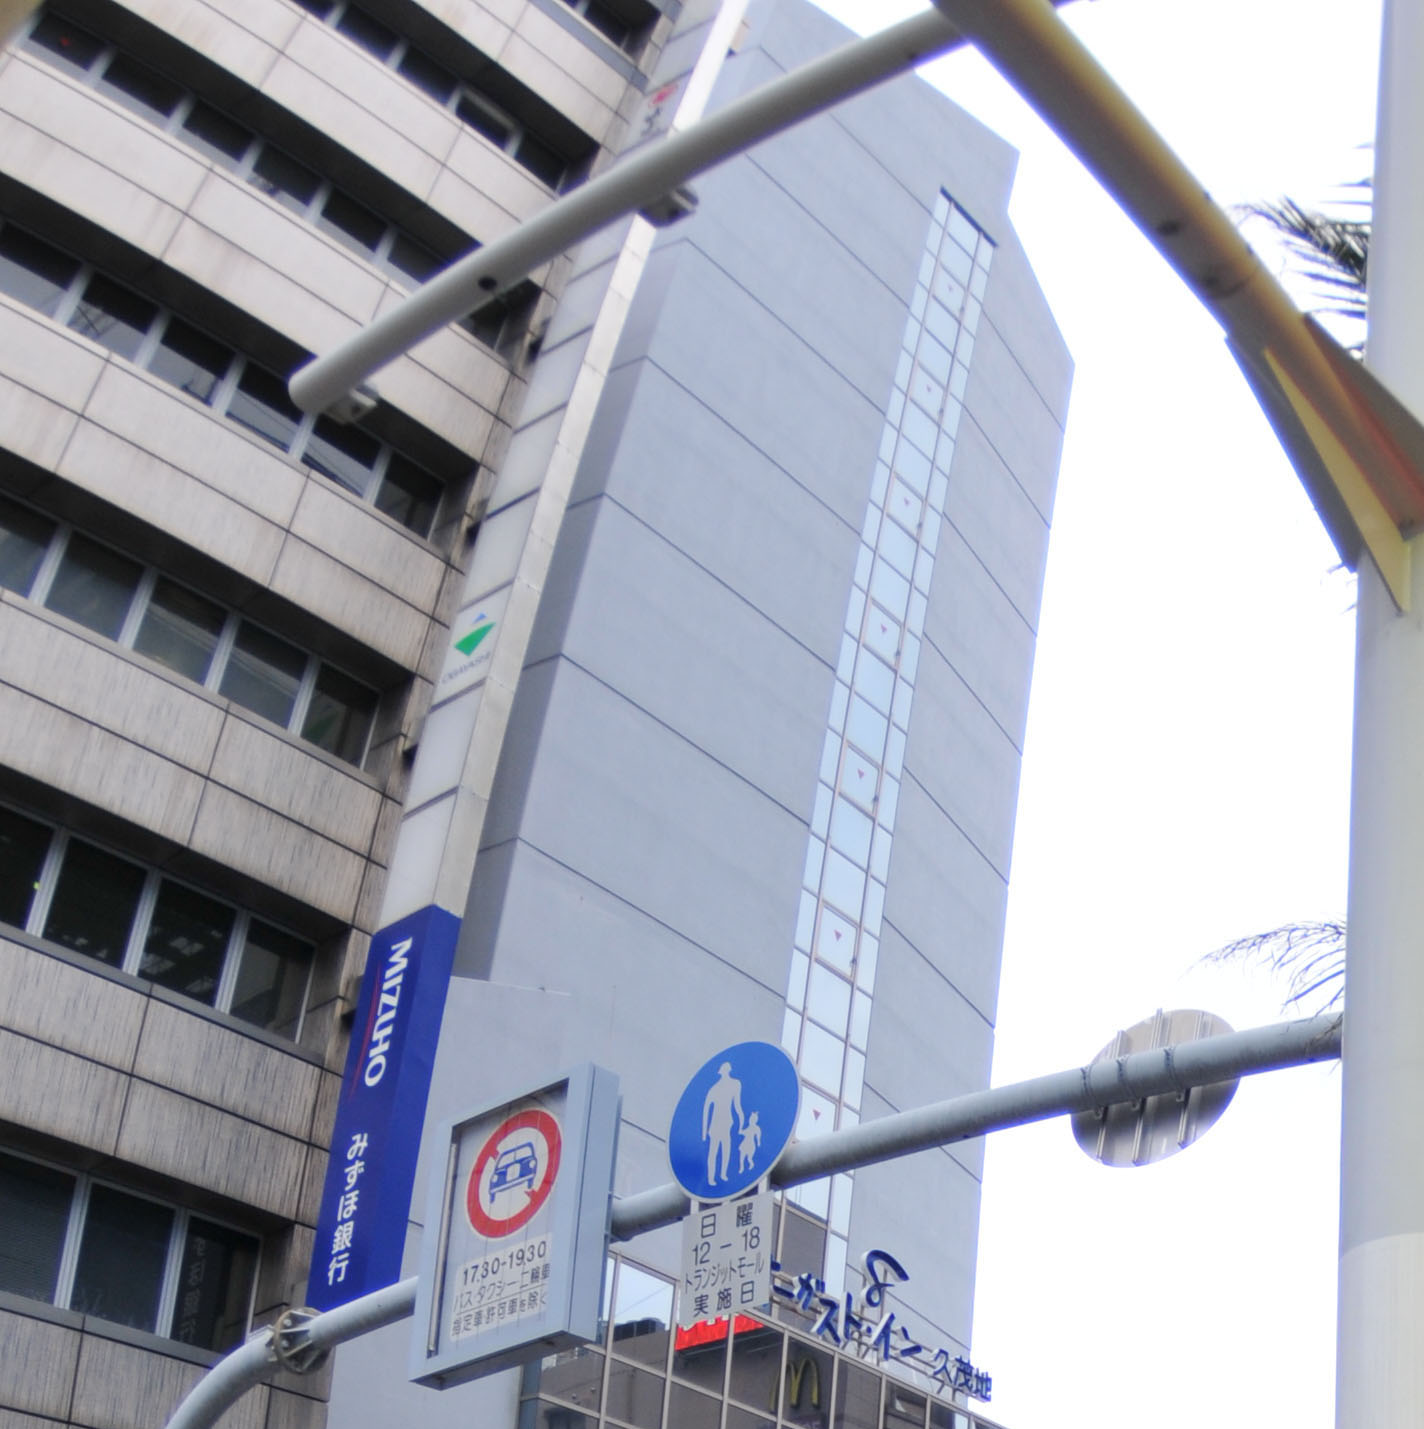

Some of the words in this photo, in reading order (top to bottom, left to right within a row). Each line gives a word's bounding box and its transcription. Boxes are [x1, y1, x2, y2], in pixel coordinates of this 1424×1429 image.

[365, 936, 413, 1088] MIZUHO
[327, 1133, 369, 1287] みずほ銀行
[685, 1252, 765, 1295] トランジットモール
[694, 1281, 755, 1318] 実施日
[771, 1254, 923, 1361] ーガスト・イン
[932, 1348, 993, 1403] 久茂地
